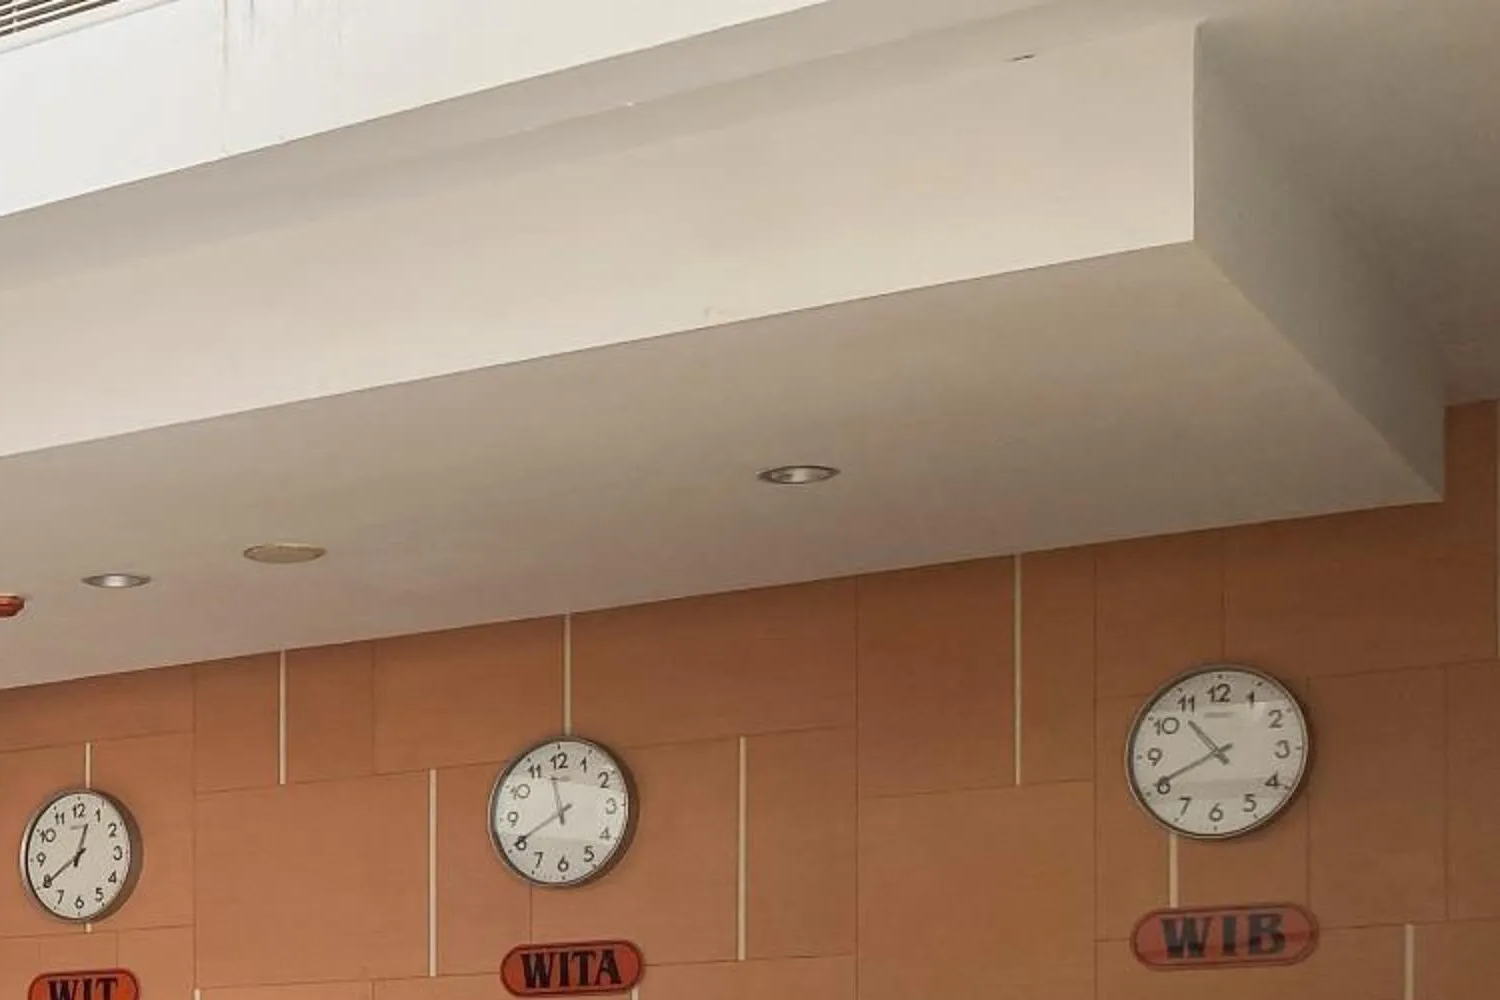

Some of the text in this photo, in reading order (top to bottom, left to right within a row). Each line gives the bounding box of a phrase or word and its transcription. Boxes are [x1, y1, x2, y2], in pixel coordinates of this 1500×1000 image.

[1207, 684, 1230, 702] 12
[1247, 692, 1254, 709] 1
[1178, 695, 1195, 712] 11
[1153, 717, 1180, 736] 10
[1268, 709, 1283, 728] 2
[1147, 748, 1162, 766] 9
[1274, 740, 1290, 759] 3
[550, 752, 568, 769] 12
[580, 757, 587, 772] 1
[528, 764, 541, 778] 11
[598, 772, 610, 788] 2
[1265, 772, 1279, 787] 4
[510, 784, 530, 799] 10
[72, 803, 85, 818] 12
[605, 797, 617, 814] 3
[1179, 797, 1192, 816] 7
[1243, 794, 1256, 812] 5
[55, 813, 65, 824] 11
[96, 809, 101, 822] 1
[507, 811, 518, 827] 9
[1209, 803, 1223, 822] 6
[40, 828, 56, 843] 10
[108, 823, 117, 837] 2
[599, 828, 611, 840] 4
[37, 855, 46, 867] 9
[113, 845, 122, 861] 3
[534, 852, 543, 868] 7
[584, 846, 594, 862] 5
[557, 856, 568, 872] 6
[43, 875, 52, 888] 8
[108, 872, 117, 883] 4
[57, 890, 64, 904] 7
[75, 896, 84, 909] 6
[96, 888, 104, 901] 5
[1160, 913, 1285, 959] WIB
[520, 949, 622, 988] WITA
